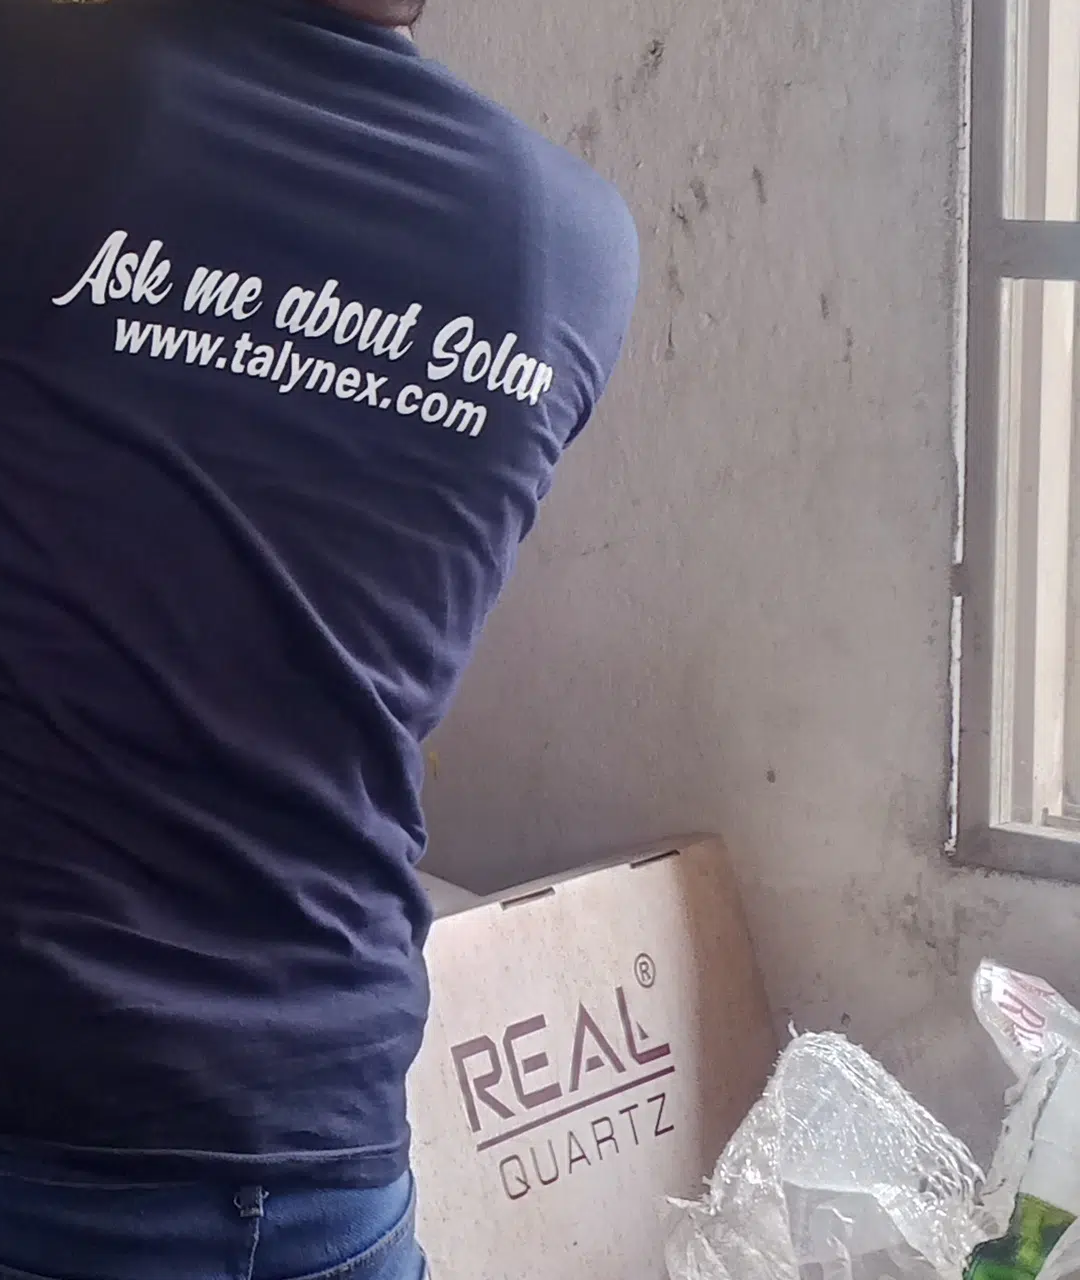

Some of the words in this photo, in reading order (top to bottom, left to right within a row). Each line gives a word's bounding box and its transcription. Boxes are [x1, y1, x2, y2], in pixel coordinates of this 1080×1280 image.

[52, 230, 173, 306] Ask
[182, 265, 262, 320] me
[274, 279, 422, 360] about
[427, 316, 554, 406] Solar
[114, 318, 489, 437] www.talynex.com
[450, 986, 671, 1132] REAL
[498, 1092, 675, 1200] QUARTZ
